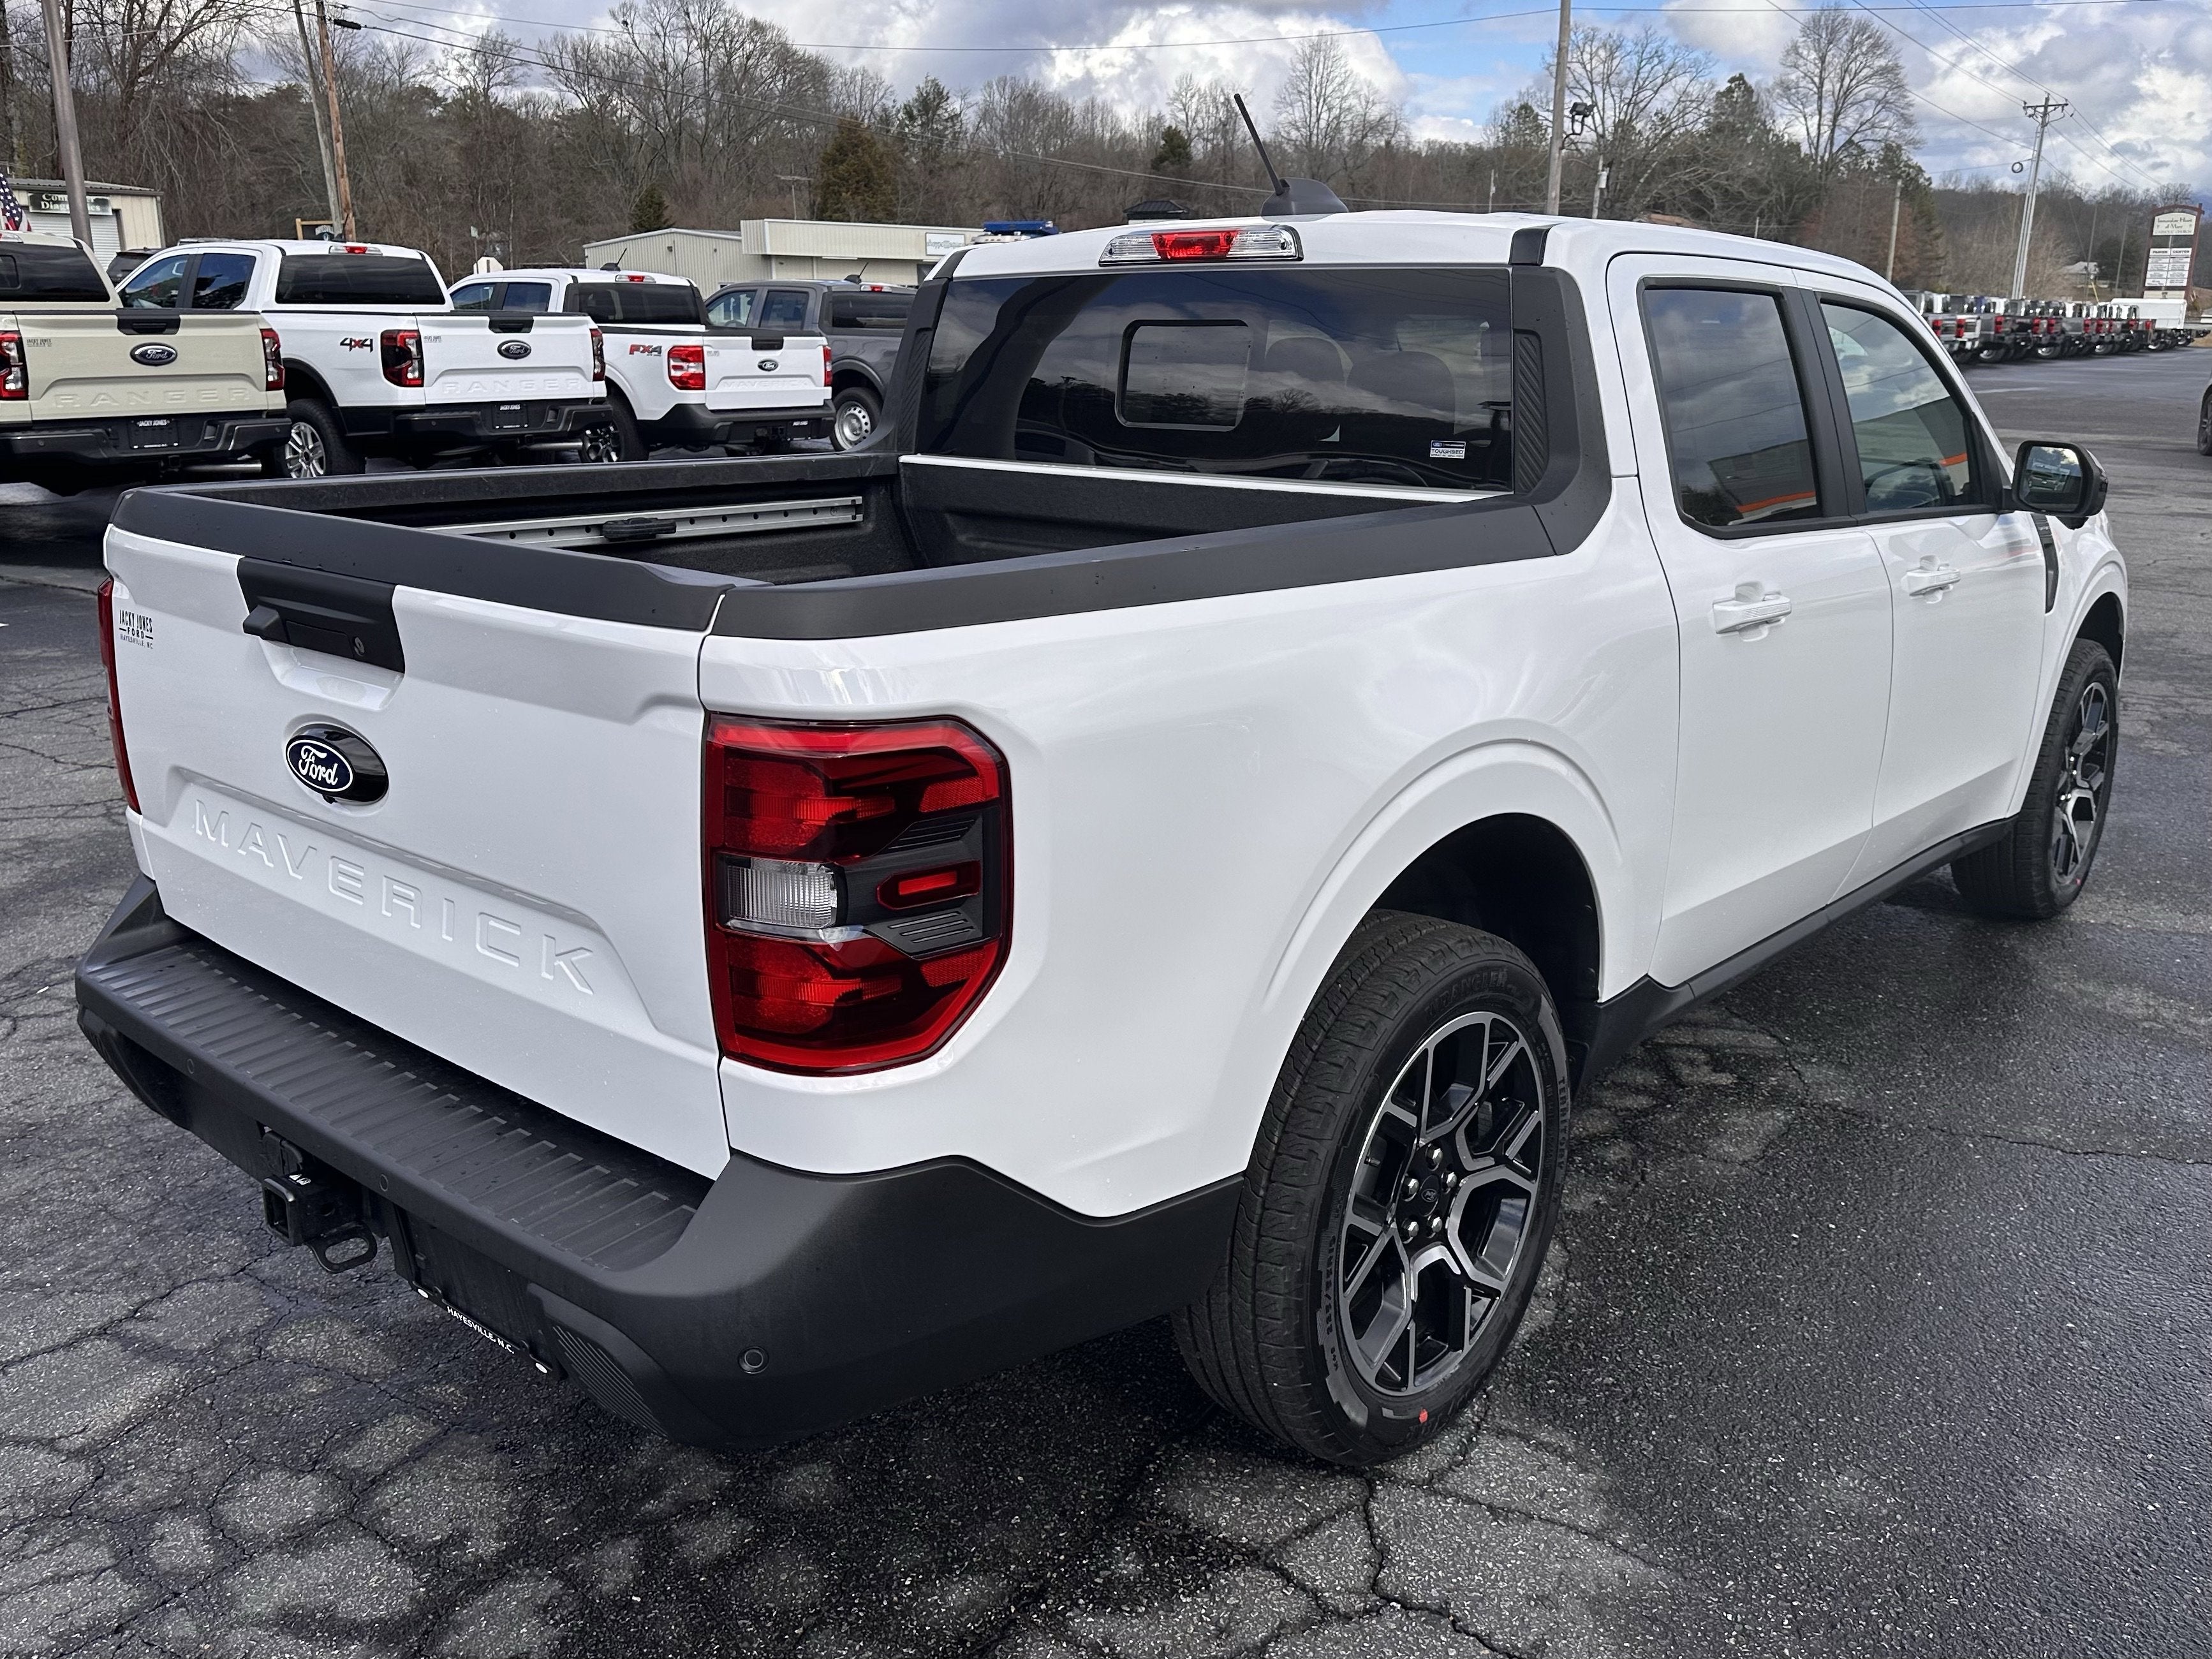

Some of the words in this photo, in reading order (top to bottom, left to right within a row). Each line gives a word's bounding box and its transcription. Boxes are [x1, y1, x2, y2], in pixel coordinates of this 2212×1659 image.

[145, 349, 168, 359] Ford
[629, 344, 662, 355] FX4
[54, 388, 251, 408] RANGER
[119, 609, 135, 628] JACKY
[136, 614, 152, 633] JONES
[128, 627, 144, 639] FORD
[299, 745, 338, 785] Ford
[195, 799, 594, 995] MAVERICK
[498, 1338, 514, 1353] N.C.
